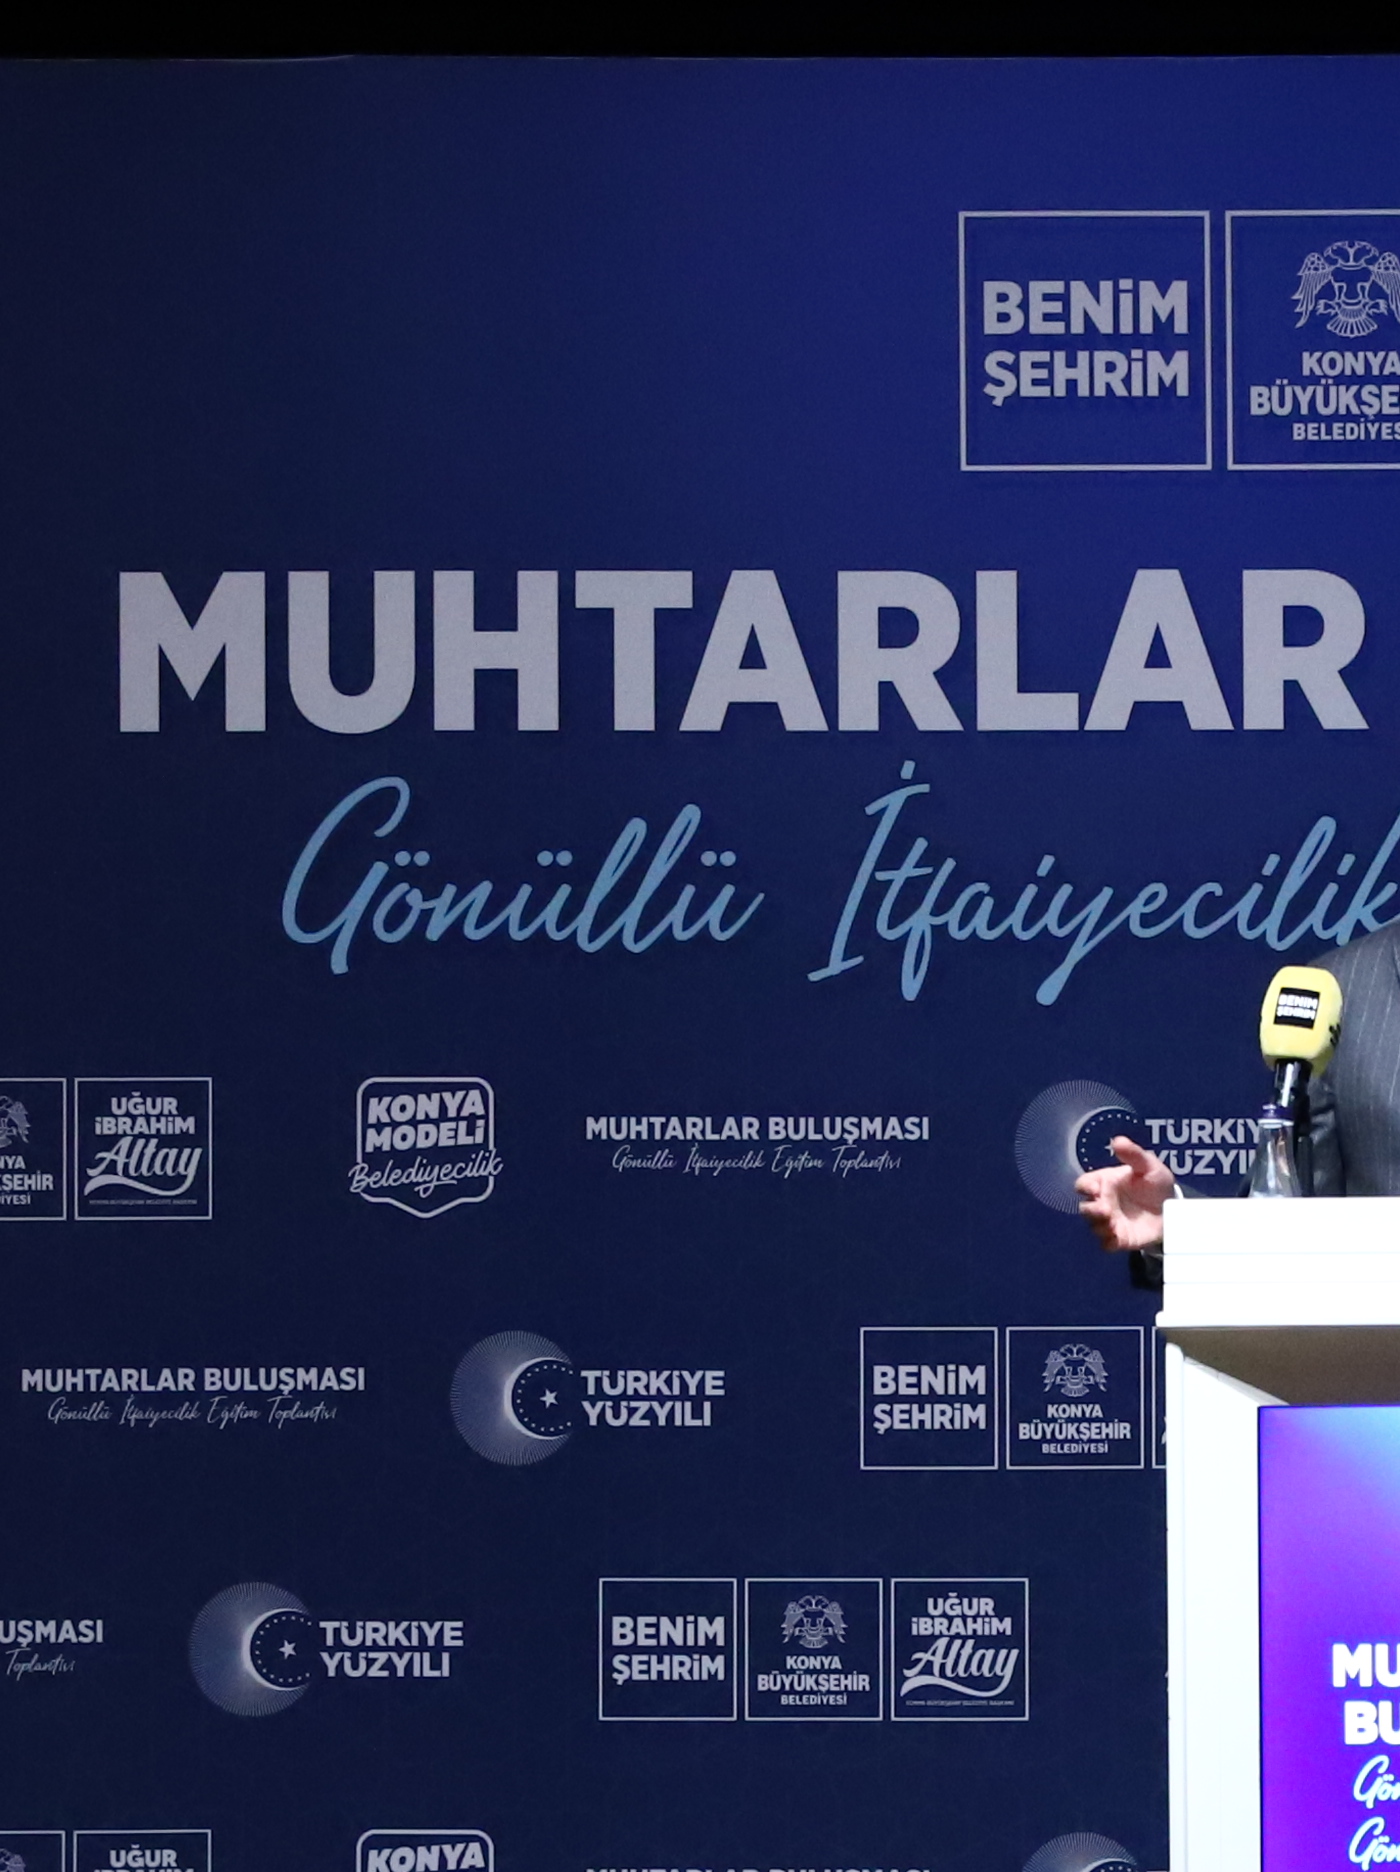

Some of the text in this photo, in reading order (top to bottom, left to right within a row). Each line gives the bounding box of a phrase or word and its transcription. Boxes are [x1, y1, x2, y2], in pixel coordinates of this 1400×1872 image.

[120, 569, 1369, 733] MUHTARLAR
[282, 777, 764, 974] Gönüllü
[111, 1092, 178, 1115] UĞUR
[367, 1089, 485, 1124] KONYA
[587, 1117, 929, 1146] MUHTARLAR BULUŞMASI
[84, 1136, 202, 1196] Altay
[348, 1148, 504, 1198] Belediyecilik
[613, 1145, 673, 1172] Gönüllü
[22, 1367, 364, 1397] MUHTARLAR BULUŞMASI
[1048, 1404, 1103, 1420] KONYA
[1019, 1419, 1131, 1443] BÜYÜKŞEHİR
[1042, 1441, 1108, 1453] BELEDİYESİ
[928, 1593, 995, 1616] UĞUR
[0, 1619, 104, 1648] UŞMASI
[786, 1656, 842, 1672] KONYA
[900, 1637, 1019, 1697] Altay
[758, 1671, 870, 1692] BÜYÜKŞEHİR
[110, 1845, 177, 1867] UĞUR
[367, 1842, 485, 1872] KONYA
